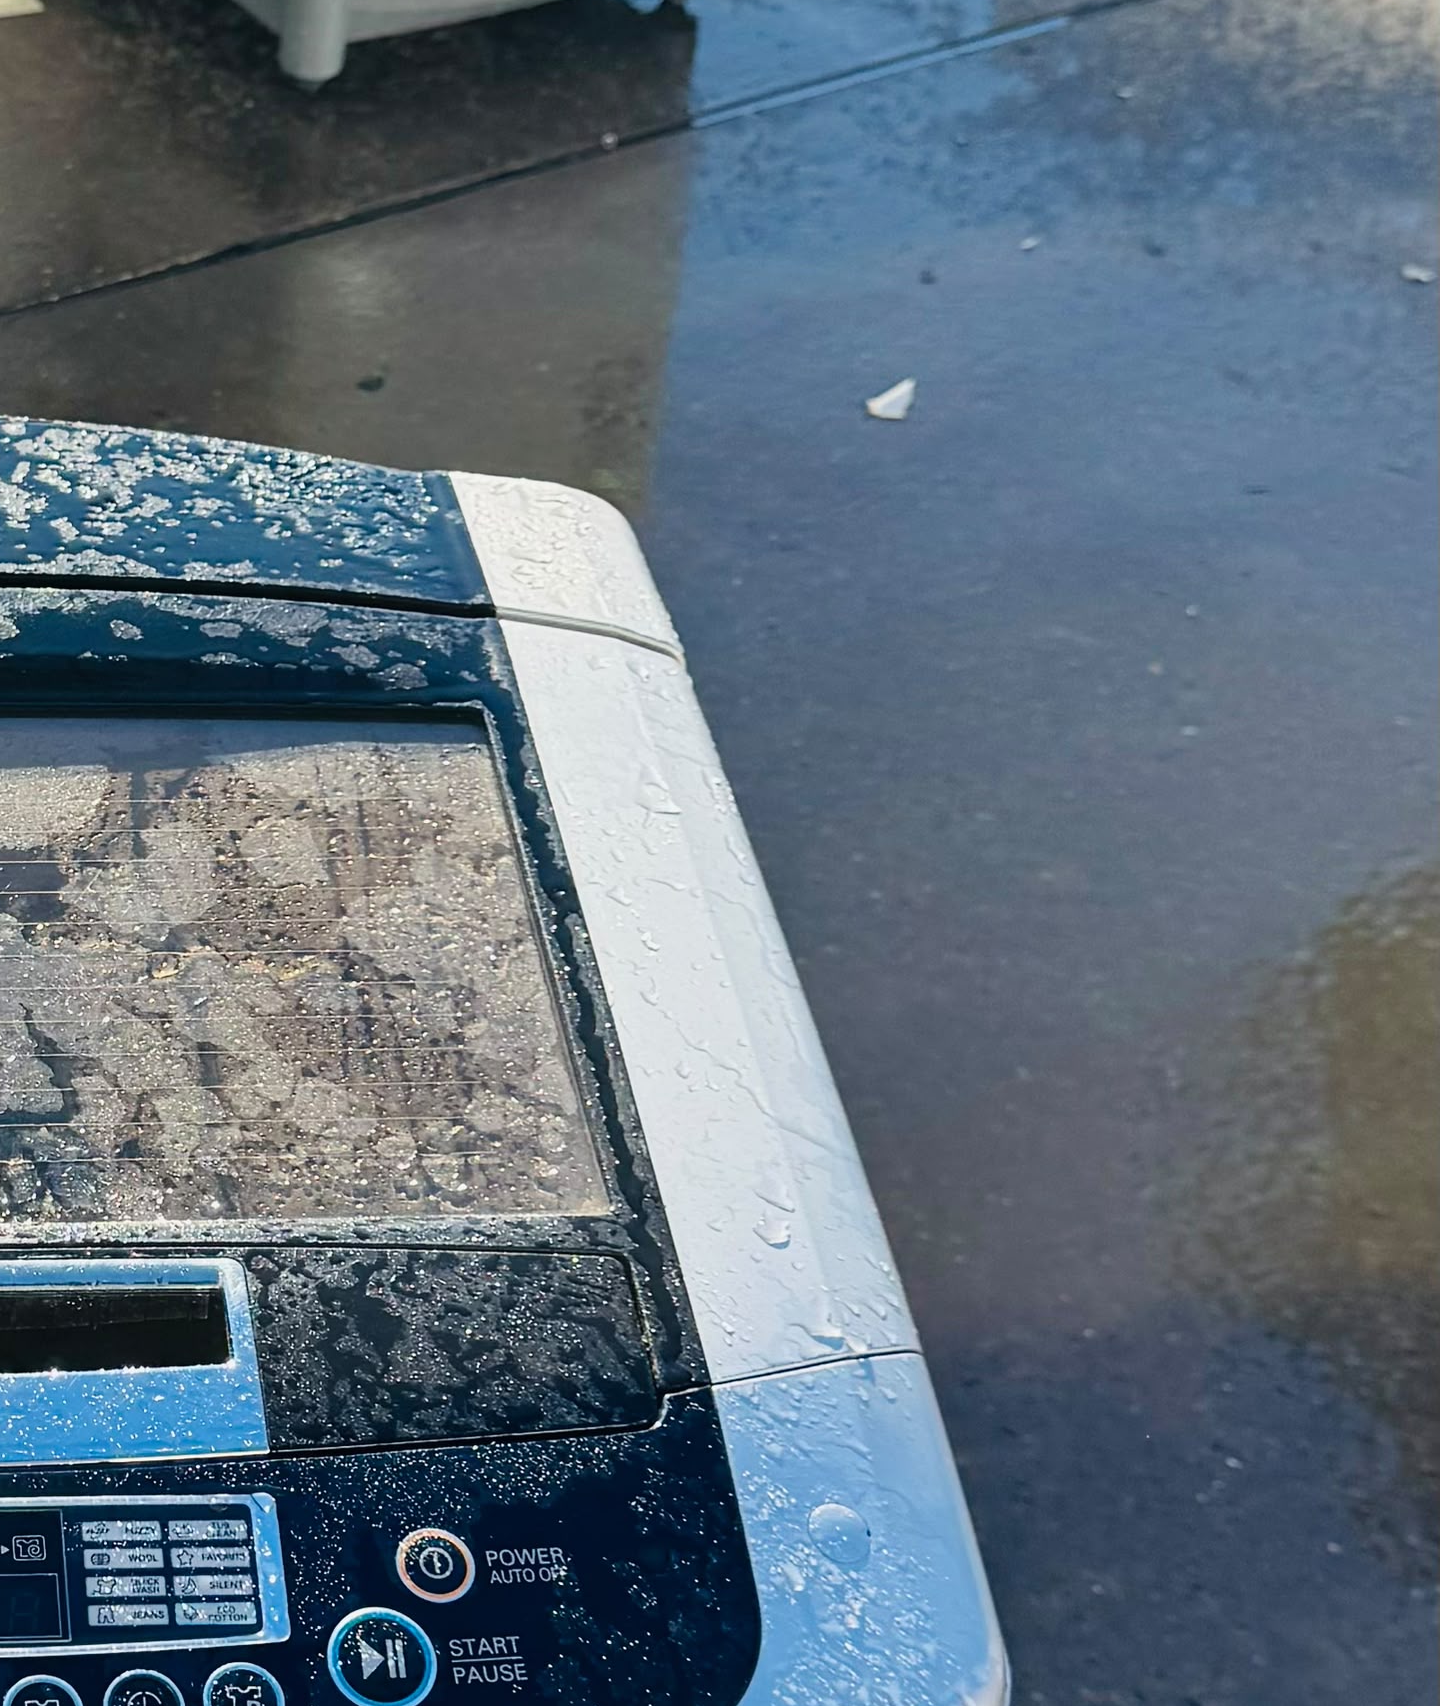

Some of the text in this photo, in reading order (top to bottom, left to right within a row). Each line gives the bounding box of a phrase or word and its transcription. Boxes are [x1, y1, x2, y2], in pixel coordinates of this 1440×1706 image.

[485, 1547, 565, 1567] POWER
[490, 1568, 536, 1584] AUTO
[449, 1636, 520, 1657] START
[452, 1663, 528, 1684] PAUSE
